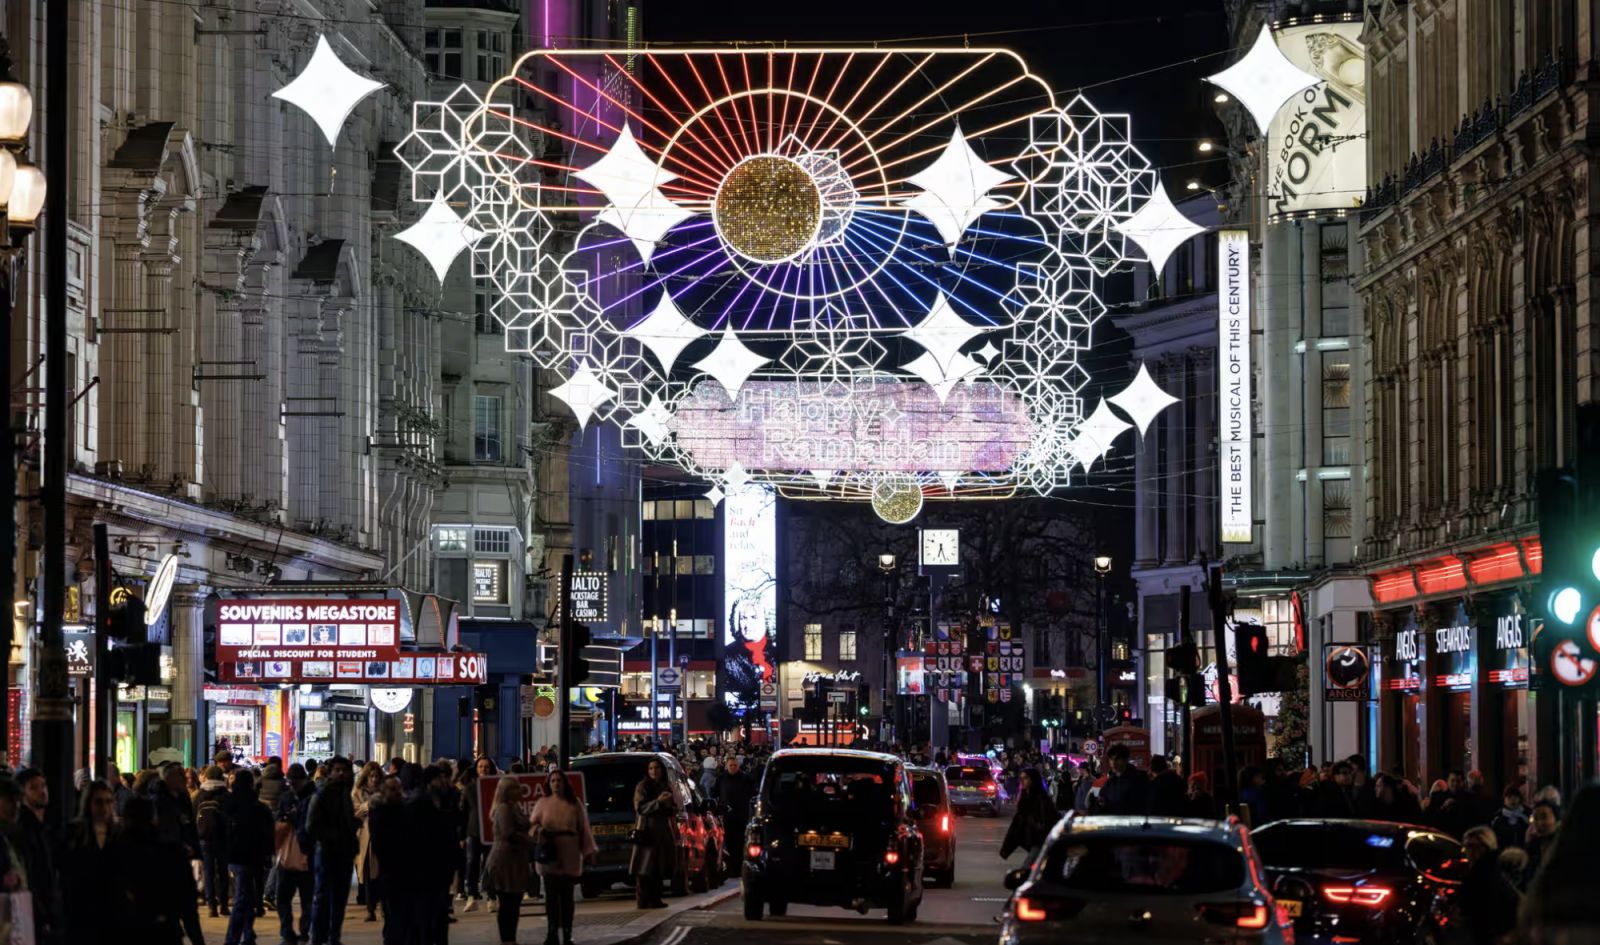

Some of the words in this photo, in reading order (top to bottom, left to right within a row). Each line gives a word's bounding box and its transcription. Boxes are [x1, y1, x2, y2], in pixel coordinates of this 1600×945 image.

[1269, 163, 1285, 199] THE
[1280, 106, 1308, 163] BOOK
[1275, 87, 1353, 214] MORM
[1229, 319, 1241, 352] THIS
[1229, 353, 1241, 374] OF
[742, 388, 880, 438] Happy
[1230, 377, 1242, 442] MUSICAL
[763, 426, 961, 463] Ramadan
[1230, 446, 1242, 482] BEST
[570, 592, 599, 600] ACKSTAGE
[571, 577, 600, 591] IALTO
[219, 605, 304, 621] SOUVENIRS
[306, 605, 396, 621] MEGASTORE
[575, 609, 598, 617] CASINO
[576, 600, 588, 609] BAR
[1395, 629, 1417, 660] ANGUS
[1435, 626, 1472, 654] STEAKHOUS
[1496, 615, 1522, 649] ANGUS
[238, 650, 271, 658] SPECIAL
[273, 650, 315, 658] DISCOUNT
[317, 650, 334, 658] FOR
[336, 650, 377, 658] STUDENTS
[1328, 689, 1368, 698] ANGUS
[1085, 743, 1096, 751] 20
